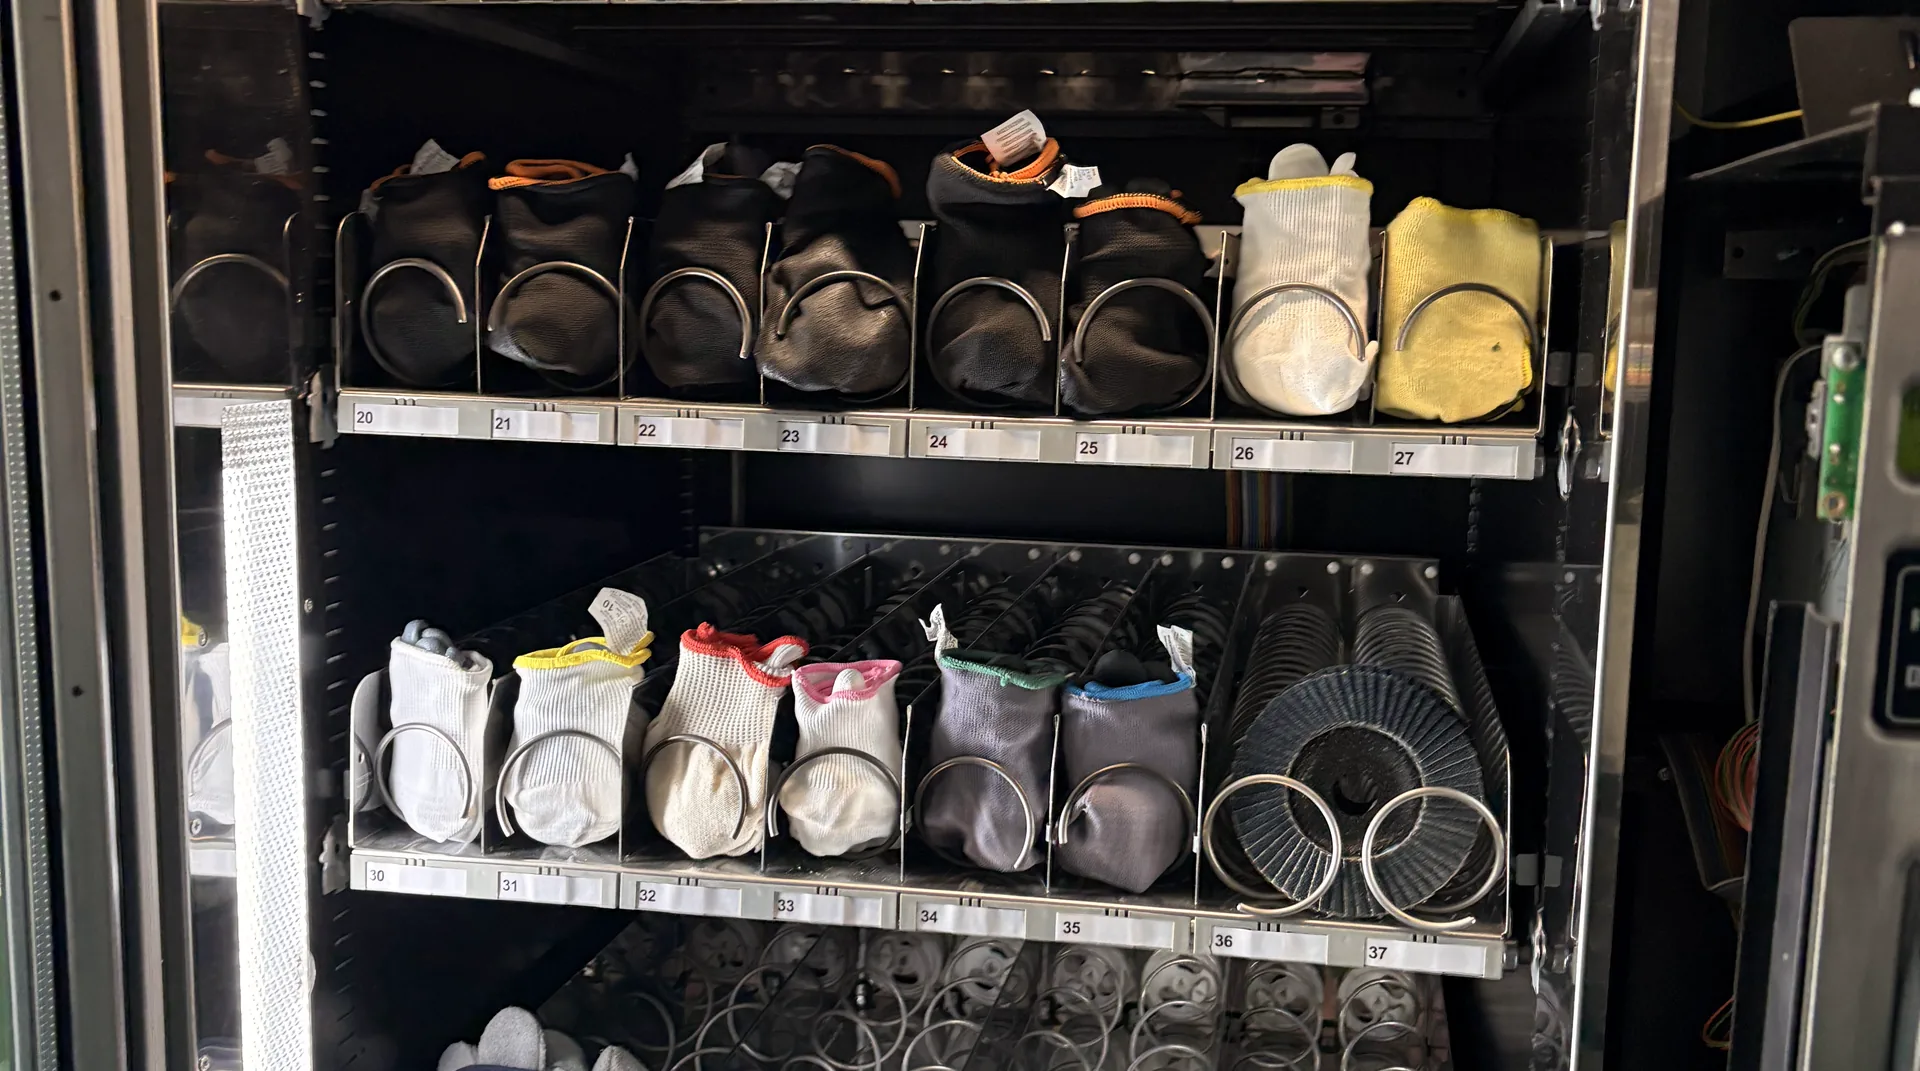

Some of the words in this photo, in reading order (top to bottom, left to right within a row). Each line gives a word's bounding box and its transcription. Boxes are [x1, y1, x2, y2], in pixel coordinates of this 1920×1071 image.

[356, 411, 373, 424] 20
[495, 417, 510, 430] 21
[638, 423, 656, 437] 22
[781, 429, 800, 444] 23
[929, 434, 948, 449] 24
[1079, 440, 1098, 455] 25
[1234, 446, 1254, 461] 26
[1394, 451, 1415, 466] 27
[602, 599, 614, 611] 10
[369, 869, 385, 882] 30
[503, 879, 517, 892] 31
[639, 889, 656, 902] 32
[777, 899, 795, 912] 33
[920, 909, 938, 923] 34
[1063, 921, 1081, 935] 35
[1215, 934, 1233, 948] 36
[1368, 945, 1388, 960] 37
